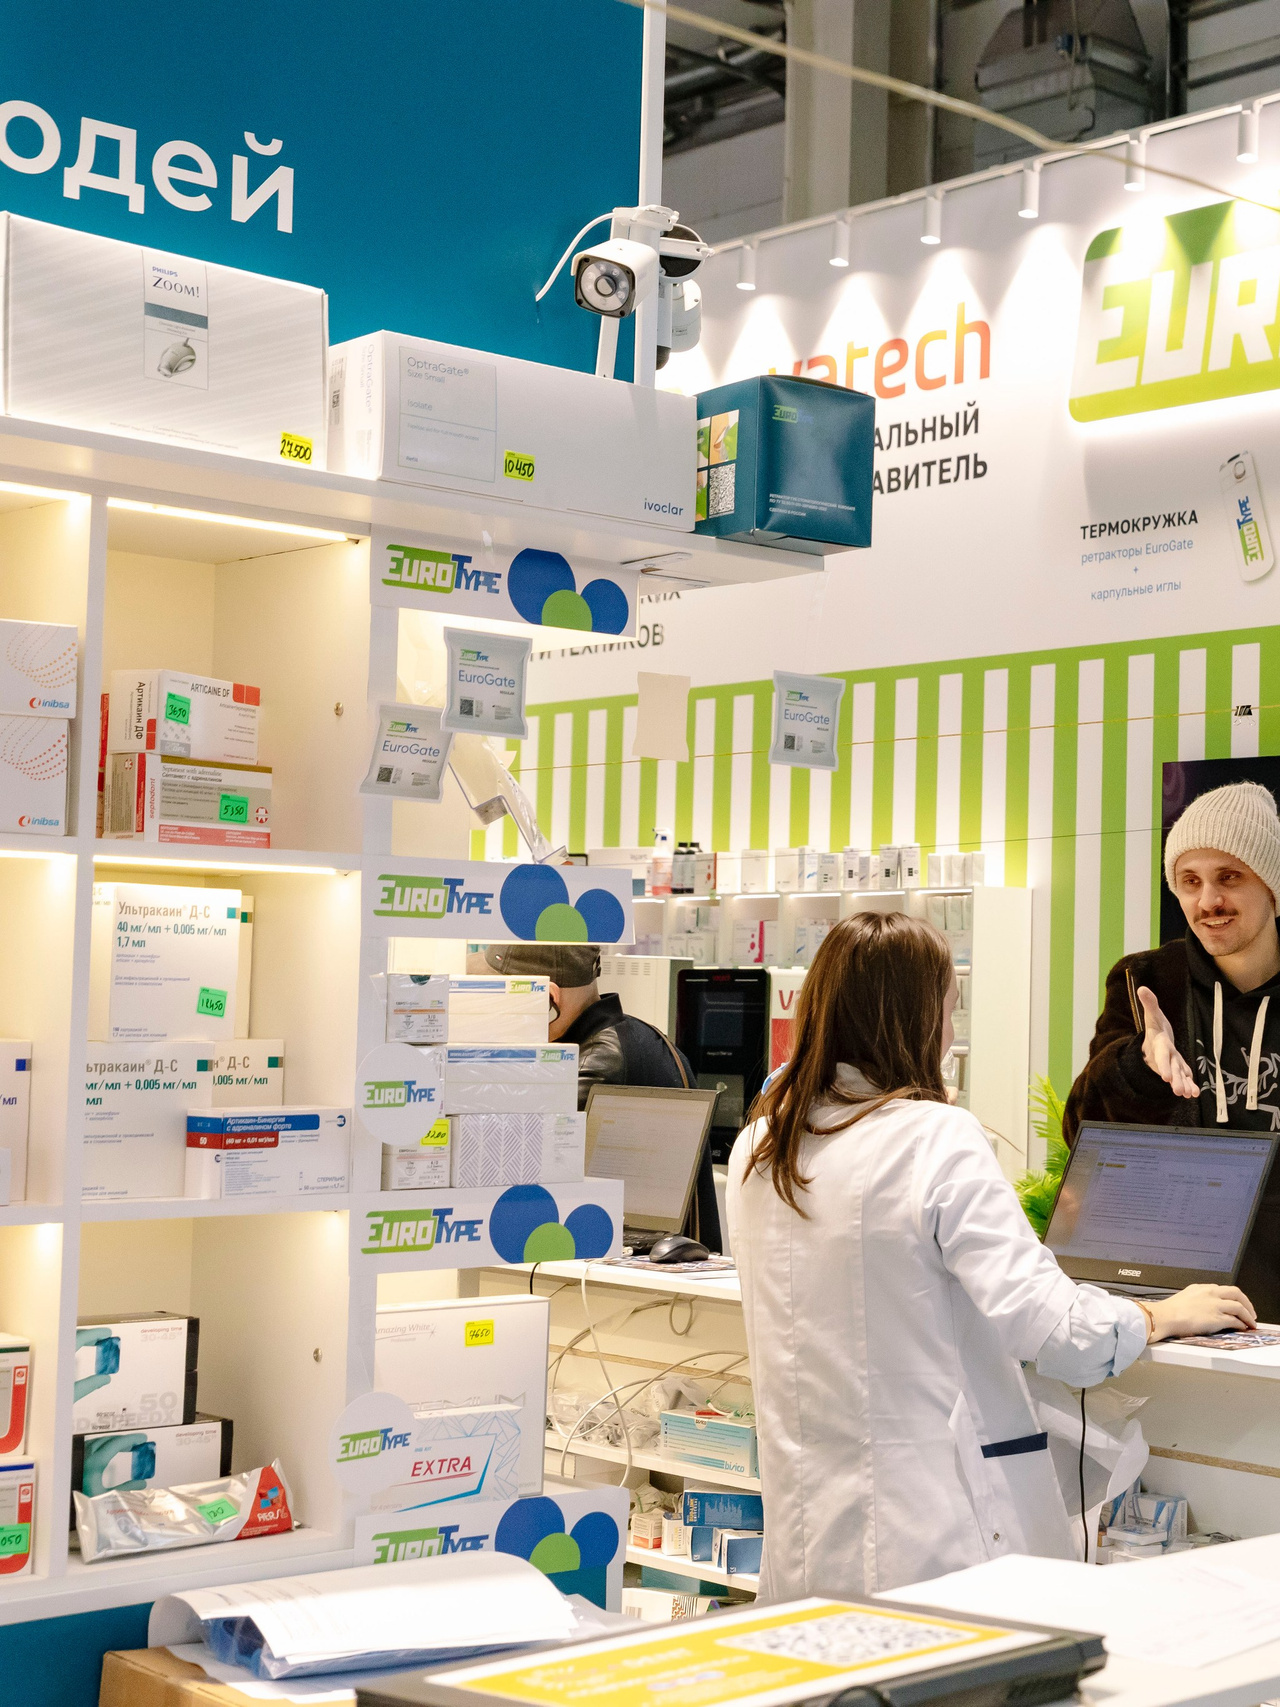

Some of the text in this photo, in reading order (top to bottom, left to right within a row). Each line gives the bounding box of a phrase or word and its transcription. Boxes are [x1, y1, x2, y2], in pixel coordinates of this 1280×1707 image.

[0, 100, 294, 233] одей
[152, 266, 178, 277] PHILIPS
[407, 369, 445, 384] Size Small
[407, 400, 433, 411] Isolate
[280, 438, 312, 462] 27500
[504, 458, 535, 478] 10450
[644, 498, 684, 516] ivoclar
[1080, 509, 1199, 540] ТЕРМОКРУЖКА
[1081, 538, 1194, 565] ретракторы EuroGate
[1091, 579, 1182, 601] карпульные иглы
[459, 669, 516, 688] EuroGate
[190, 682, 230, 698] ARTICAINE DF
[42, 697, 70, 709] inibsa
[134, 681, 146, 740] Артикаин ДФ
[168, 704, 187, 718] 3650
[784, 708, 830, 726] EuroGate
[382, 740, 440, 758] EuroGate
[31, 815, 60, 827] inibsa
[117, 921, 128, 932] 40
[130, 922, 161, 934] мг/мл
[173, 923, 195, 936] 0,005
[197, 924, 227, 936] мг/мл
[117, 936, 146, 948] 1,7 мл
[154, 1059, 178, 1075] Д-С
[227, 1056, 250, 1070] Д-С
[135, 1079, 160, 1091] 0,005
[163, 1078, 197, 1091] мг/мл
[236, 1073, 268, 1085] мг/мл
[86, 1097, 103, 1106] мл
[408, 1322, 431, 1332] White
[139, 1392, 178, 1411] 50
[410, 1456, 472, 1477] EXTRA
[724, 1461, 745, 1473] bisico
